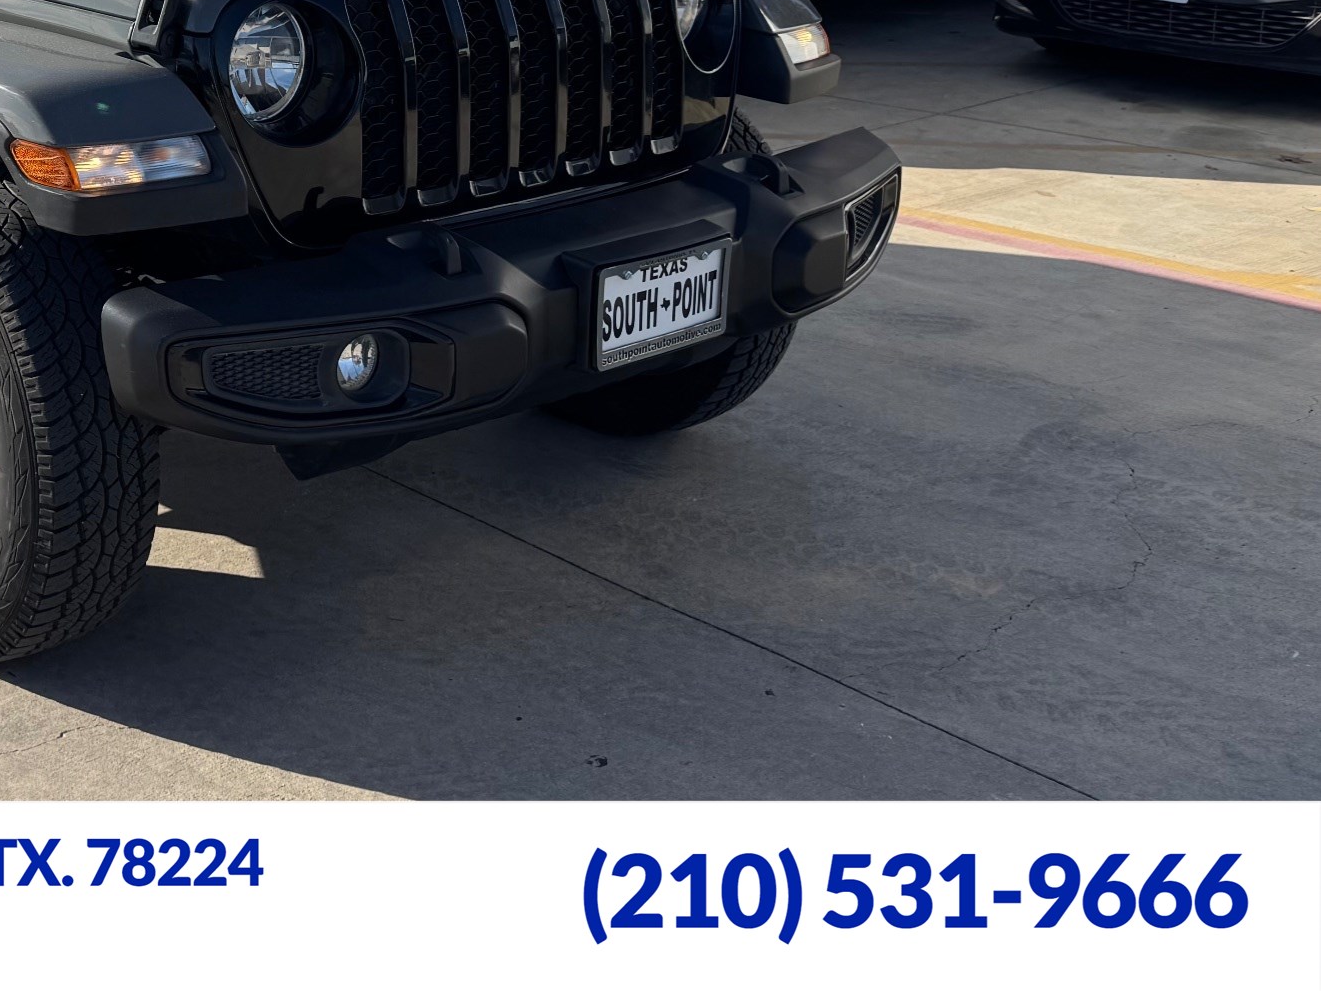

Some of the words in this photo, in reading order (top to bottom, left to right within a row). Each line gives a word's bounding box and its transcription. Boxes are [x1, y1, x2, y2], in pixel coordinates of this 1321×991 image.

[640, 257, 688, 283] TEXAS
[602, 287, 658, 342] SOUTH
[672, 269, 717, 322] POINT
[601, 322, 722, 367] southpointautomotive.com
